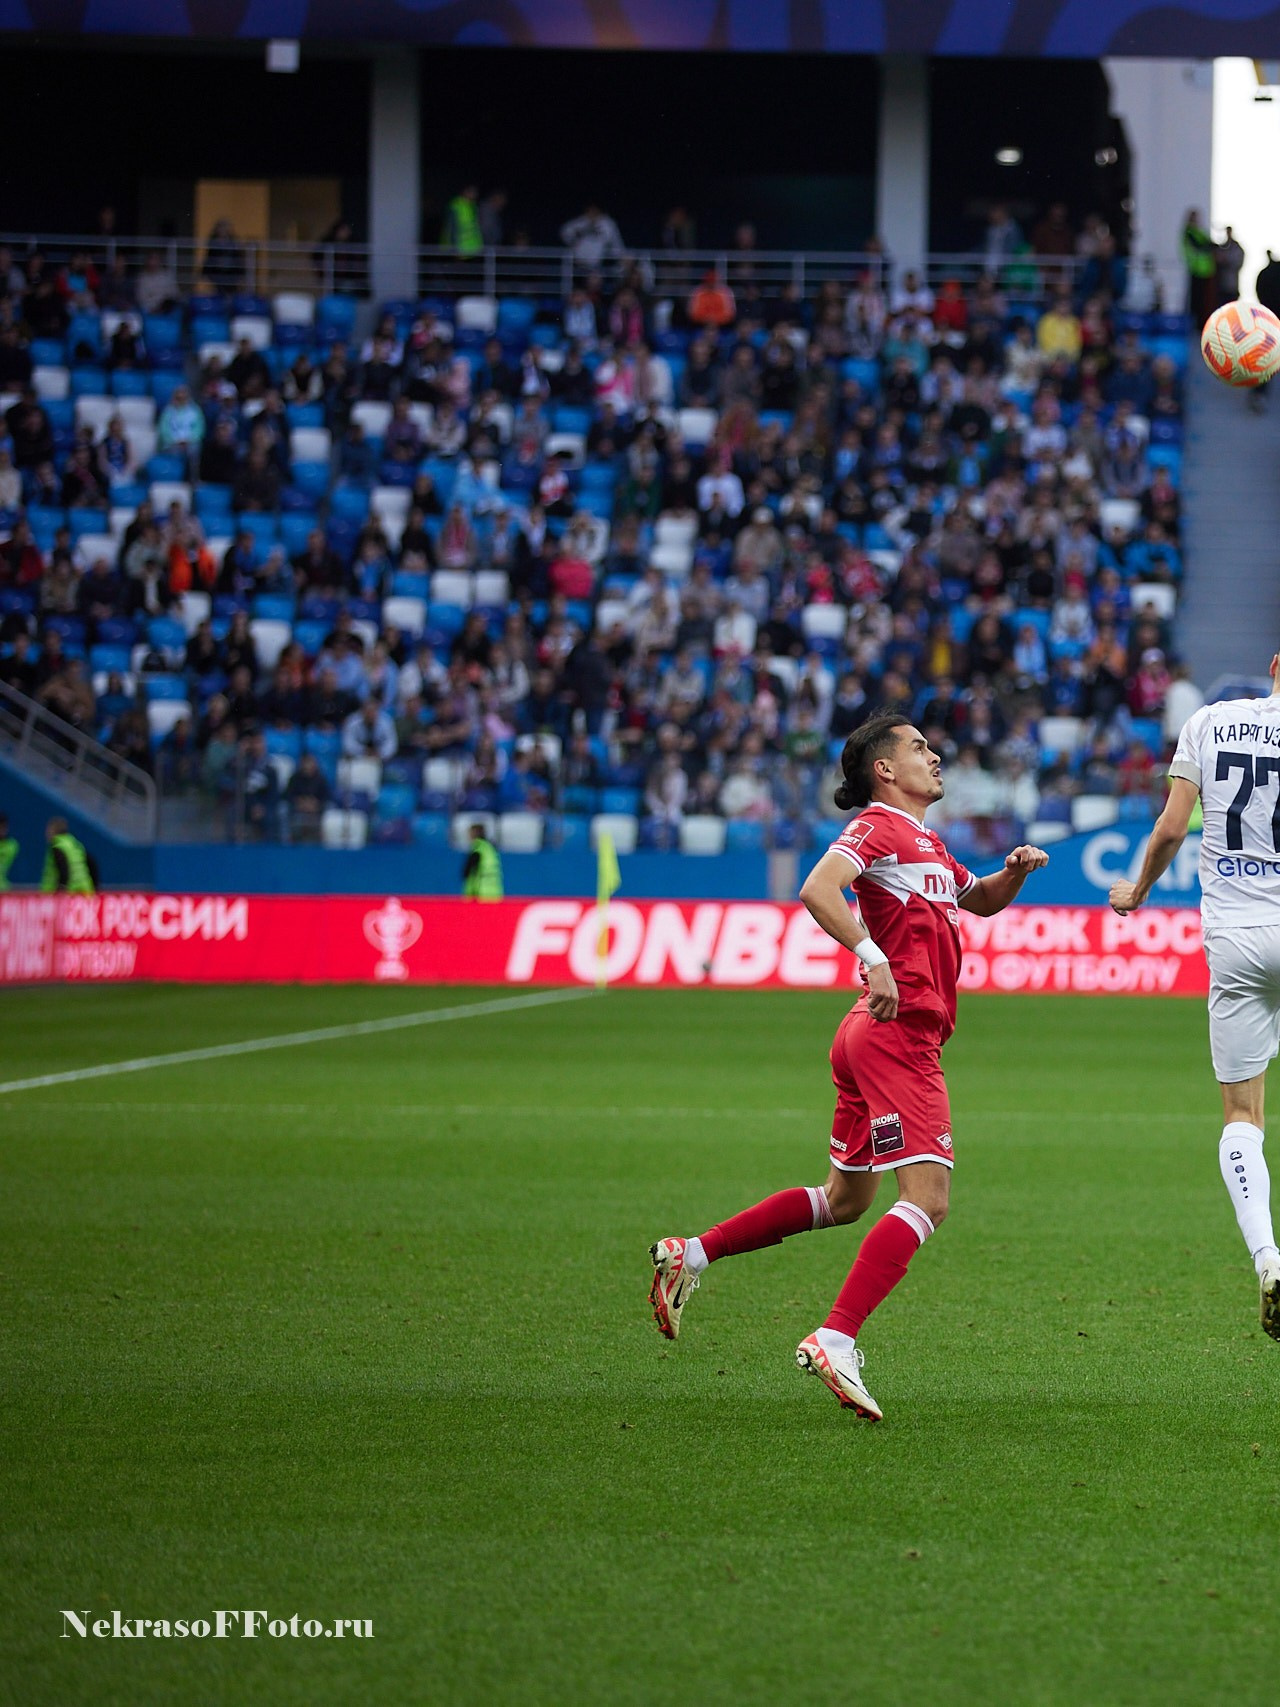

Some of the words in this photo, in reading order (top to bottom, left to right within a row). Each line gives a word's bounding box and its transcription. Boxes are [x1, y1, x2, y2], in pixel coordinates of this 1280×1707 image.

[504, 901, 862, 986] FONBE
[1102, 909, 1202, 955] РОС
[990, 953, 1181, 992] ФУТБОЛУ
[871, 1113, 899, 1127] ЛУКОЙЛ
